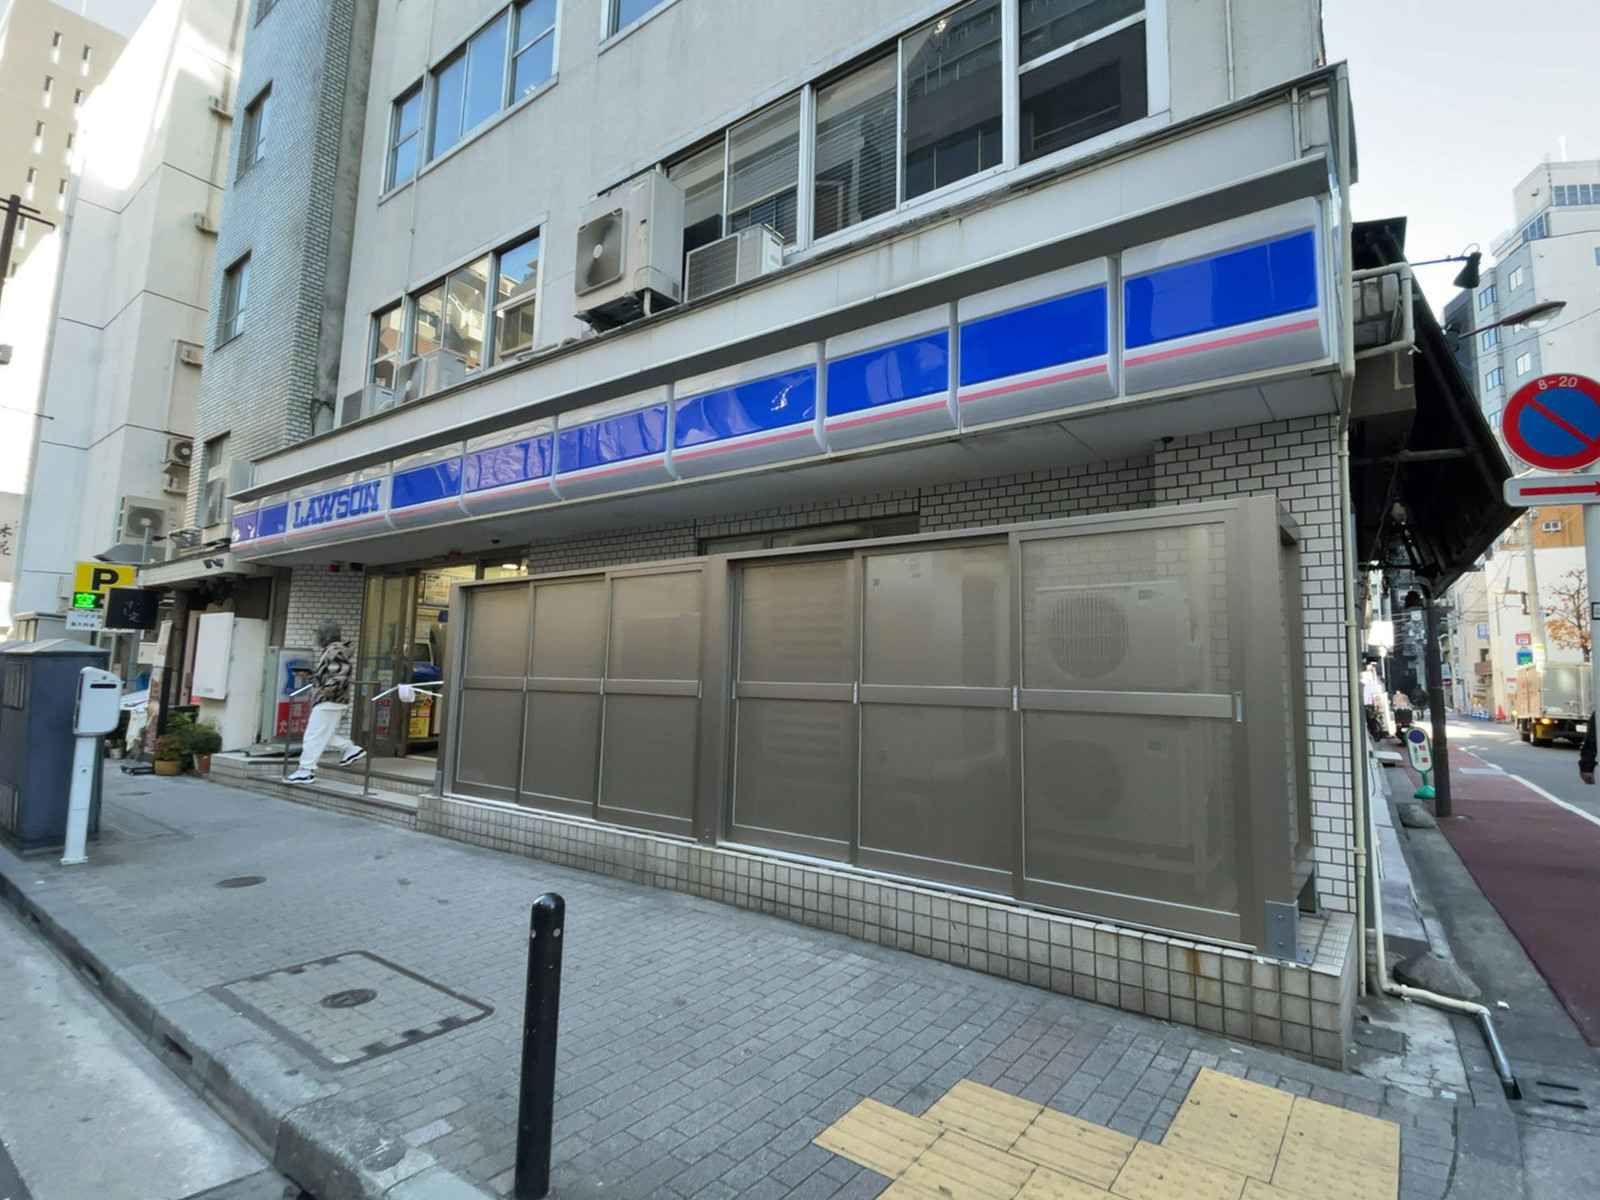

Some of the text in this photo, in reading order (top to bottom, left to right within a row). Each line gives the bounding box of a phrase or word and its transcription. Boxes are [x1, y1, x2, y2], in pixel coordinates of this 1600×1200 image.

[1537, 375, 1578, 390] 8-20
[293, 479, 381, 528] LAWSON
[91, 567, 119, 590] P
